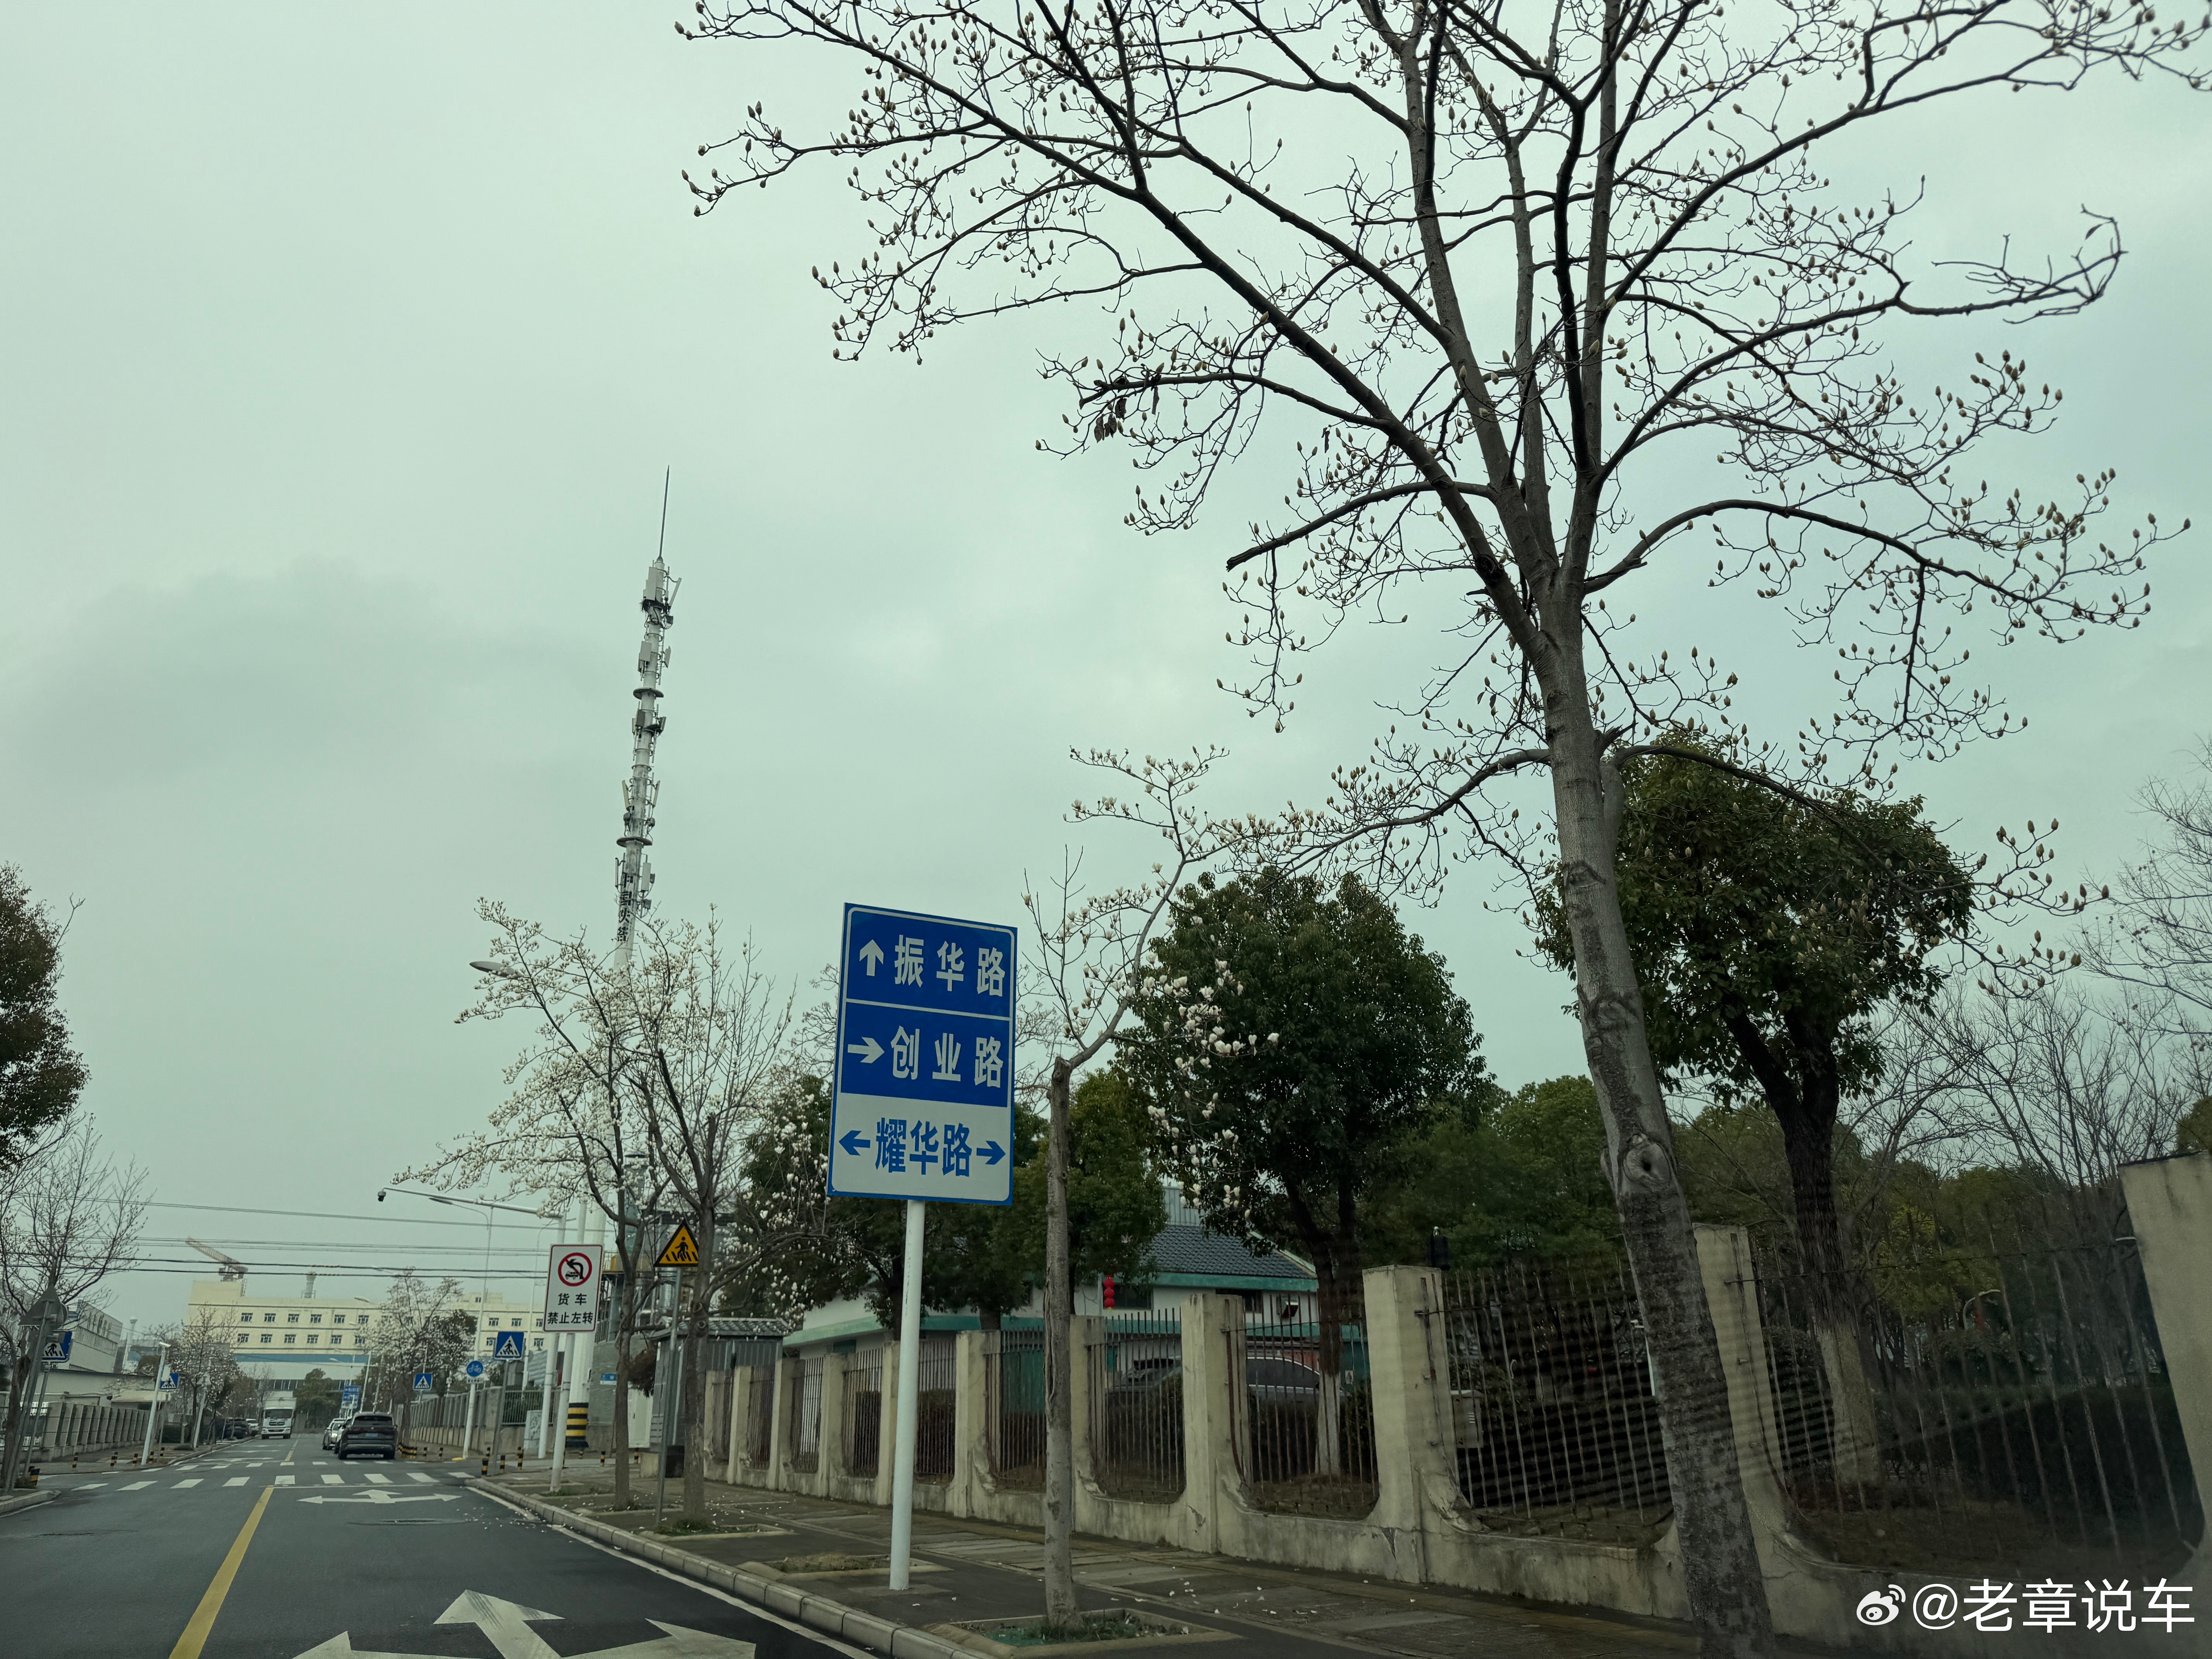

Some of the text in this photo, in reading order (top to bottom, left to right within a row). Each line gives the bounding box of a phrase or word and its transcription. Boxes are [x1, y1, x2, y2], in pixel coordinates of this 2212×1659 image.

[895, 934, 1006, 996] 振华路
[890, 1025, 1004, 1088] 创业路
[875, 1117, 972, 1177] 耀华路
[547, 1312, 593, 1324] 禁止左转
[558, 1293, 587, 1305] 货车
